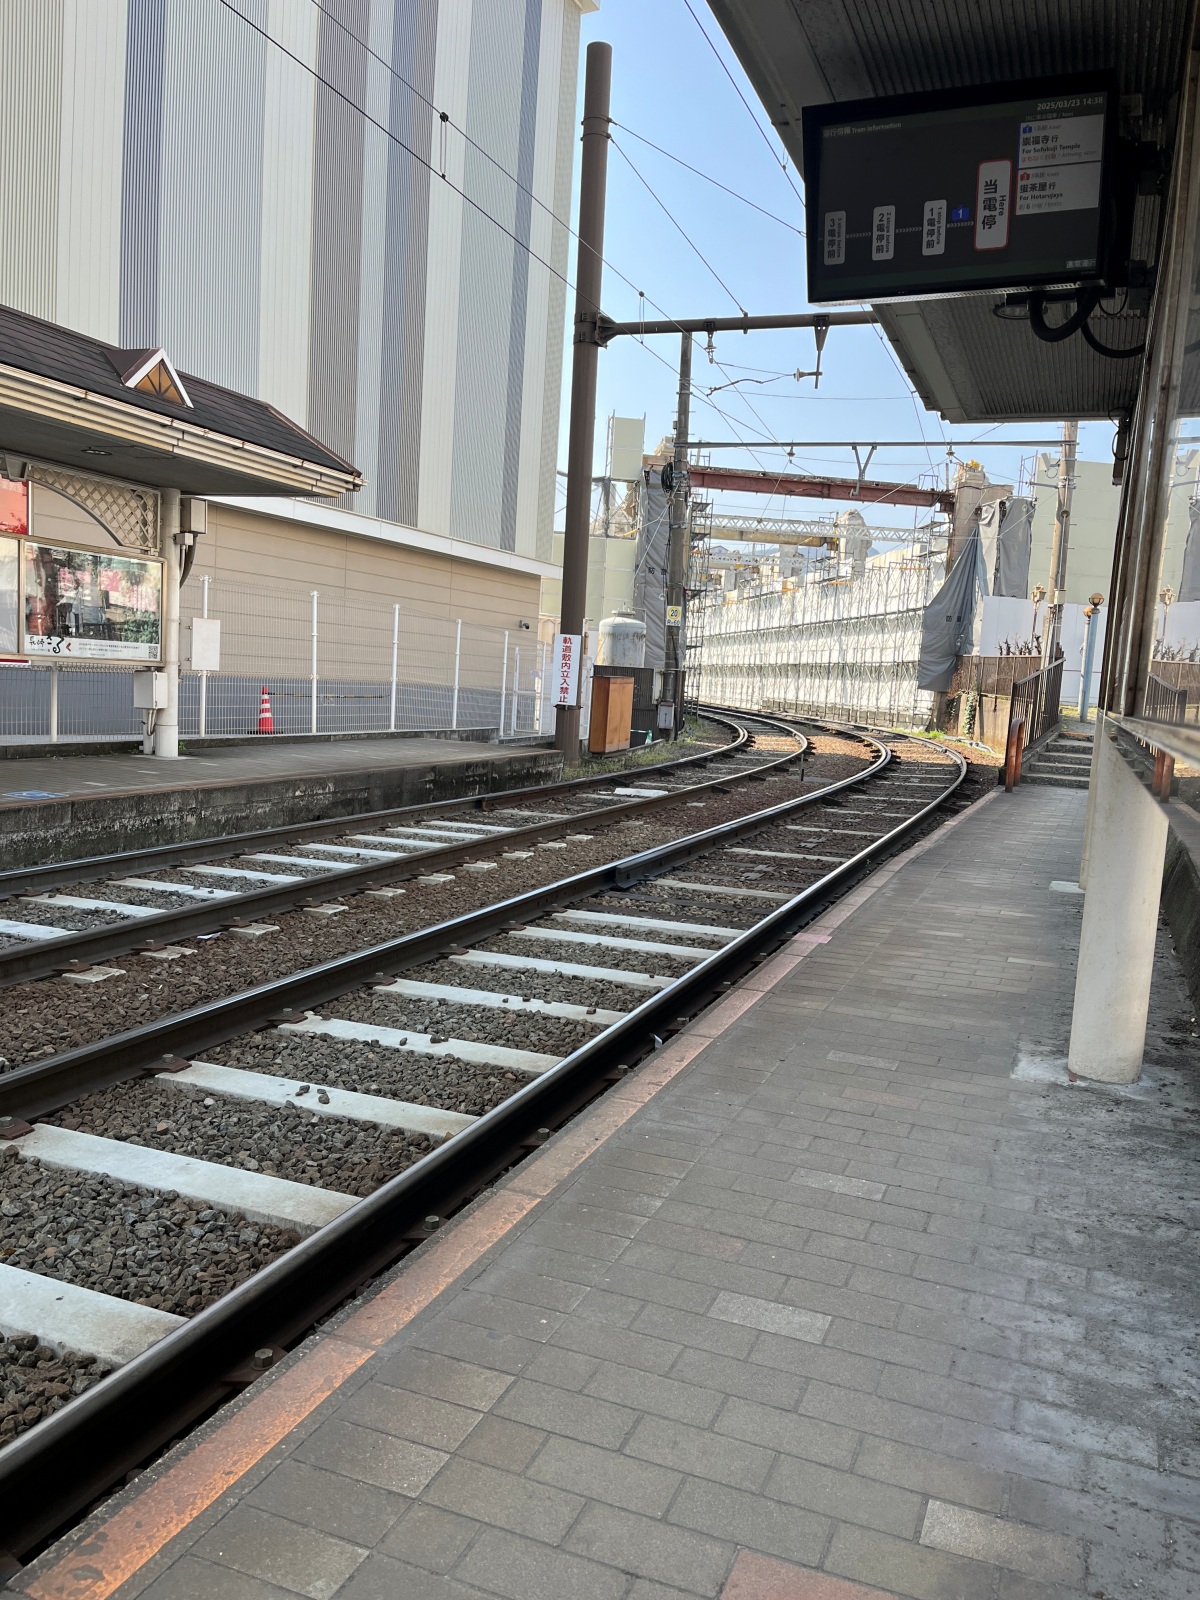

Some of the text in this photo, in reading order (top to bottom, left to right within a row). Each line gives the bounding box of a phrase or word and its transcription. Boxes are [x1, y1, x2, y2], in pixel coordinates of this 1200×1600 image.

[1036, 98, 1081, 111] 2025/03/23
[1059, 143, 1081, 151] Temple
[981, 179, 998, 230] 当電停
[998, 195, 1007, 217] Here
[827, 218, 837, 259] 3電停前
[875, 213, 886, 254] 2電停前
[925, 207, 936, 249] 1電停前
[670, 609, 679, 617] 20
[559, 636, 573, 703] 軌道敷内立入禁止
